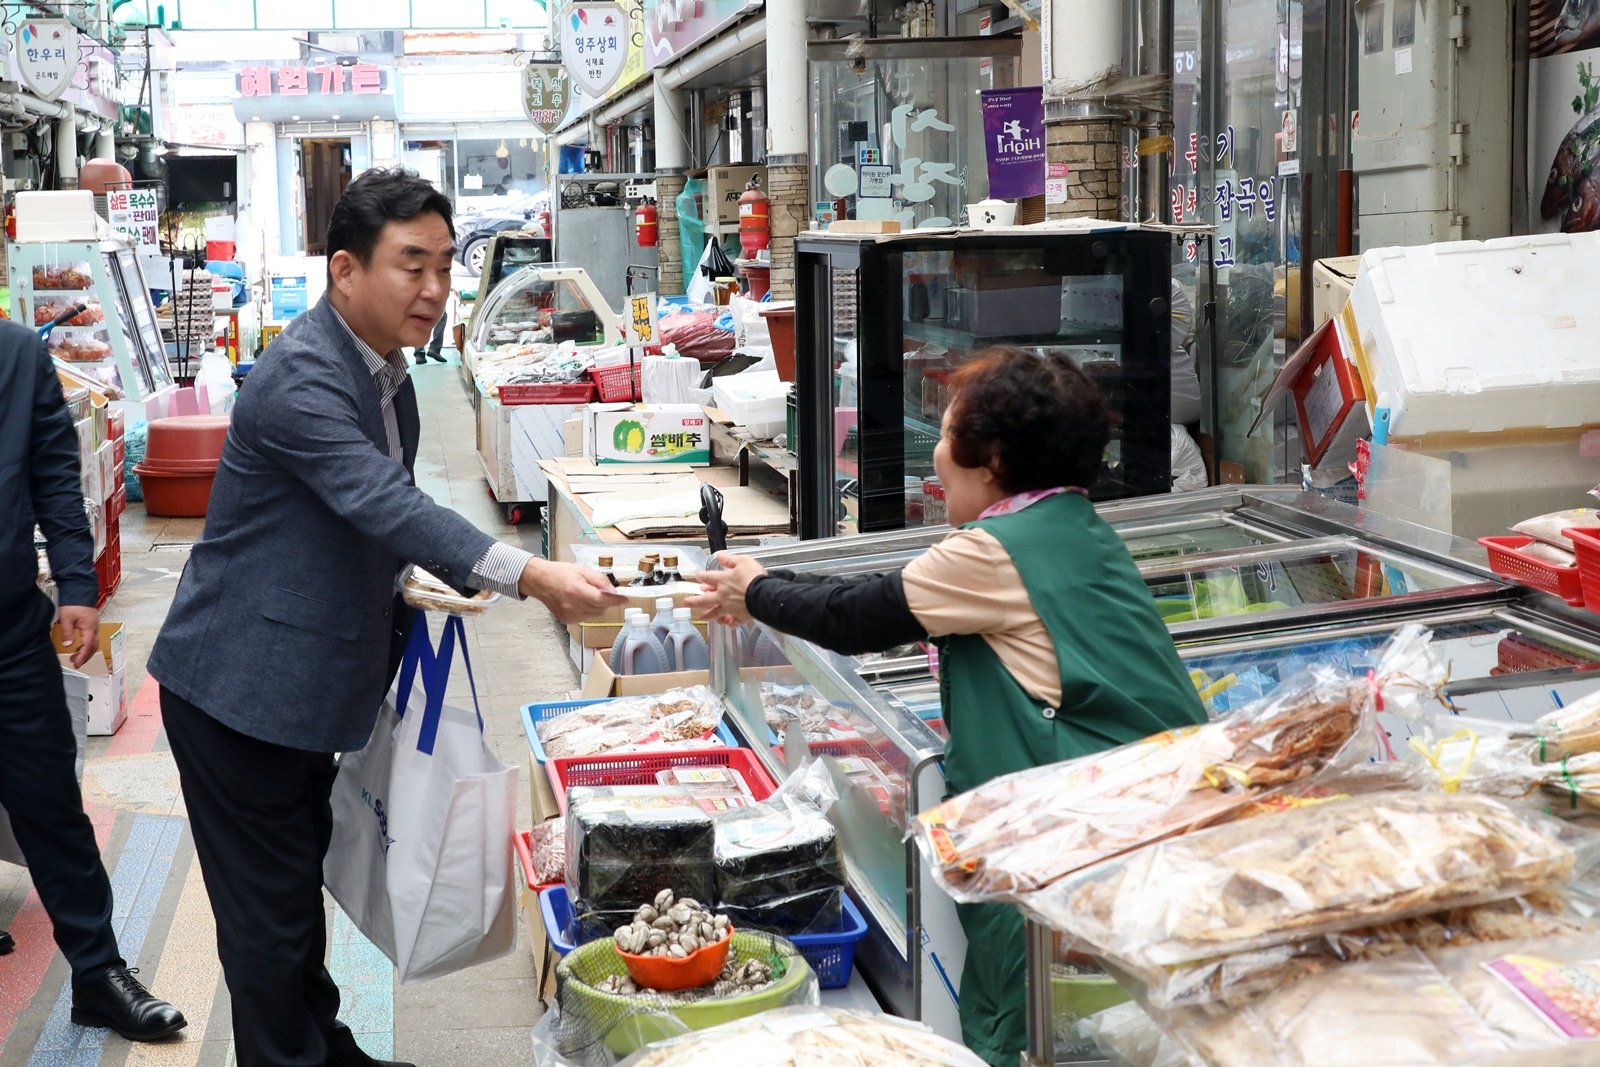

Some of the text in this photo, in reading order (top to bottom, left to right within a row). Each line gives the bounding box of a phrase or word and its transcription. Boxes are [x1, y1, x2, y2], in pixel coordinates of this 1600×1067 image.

[575, 36, 617, 54] 영주상회
[26, 48, 66, 63] 한우리
[585, 58, 605, 67] 식재료
[240, 63, 381, 97] 혜원가든
[588, 69, 602, 79] 반찬
[531, 109, 563, 123] 방앗간
[109, 193, 156, 211] 삶은 옥수수
[132, 209, 157, 222] 판매
[141, 225, 158, 246] 판매
[650, 432, 702, 448] 쌈배추
